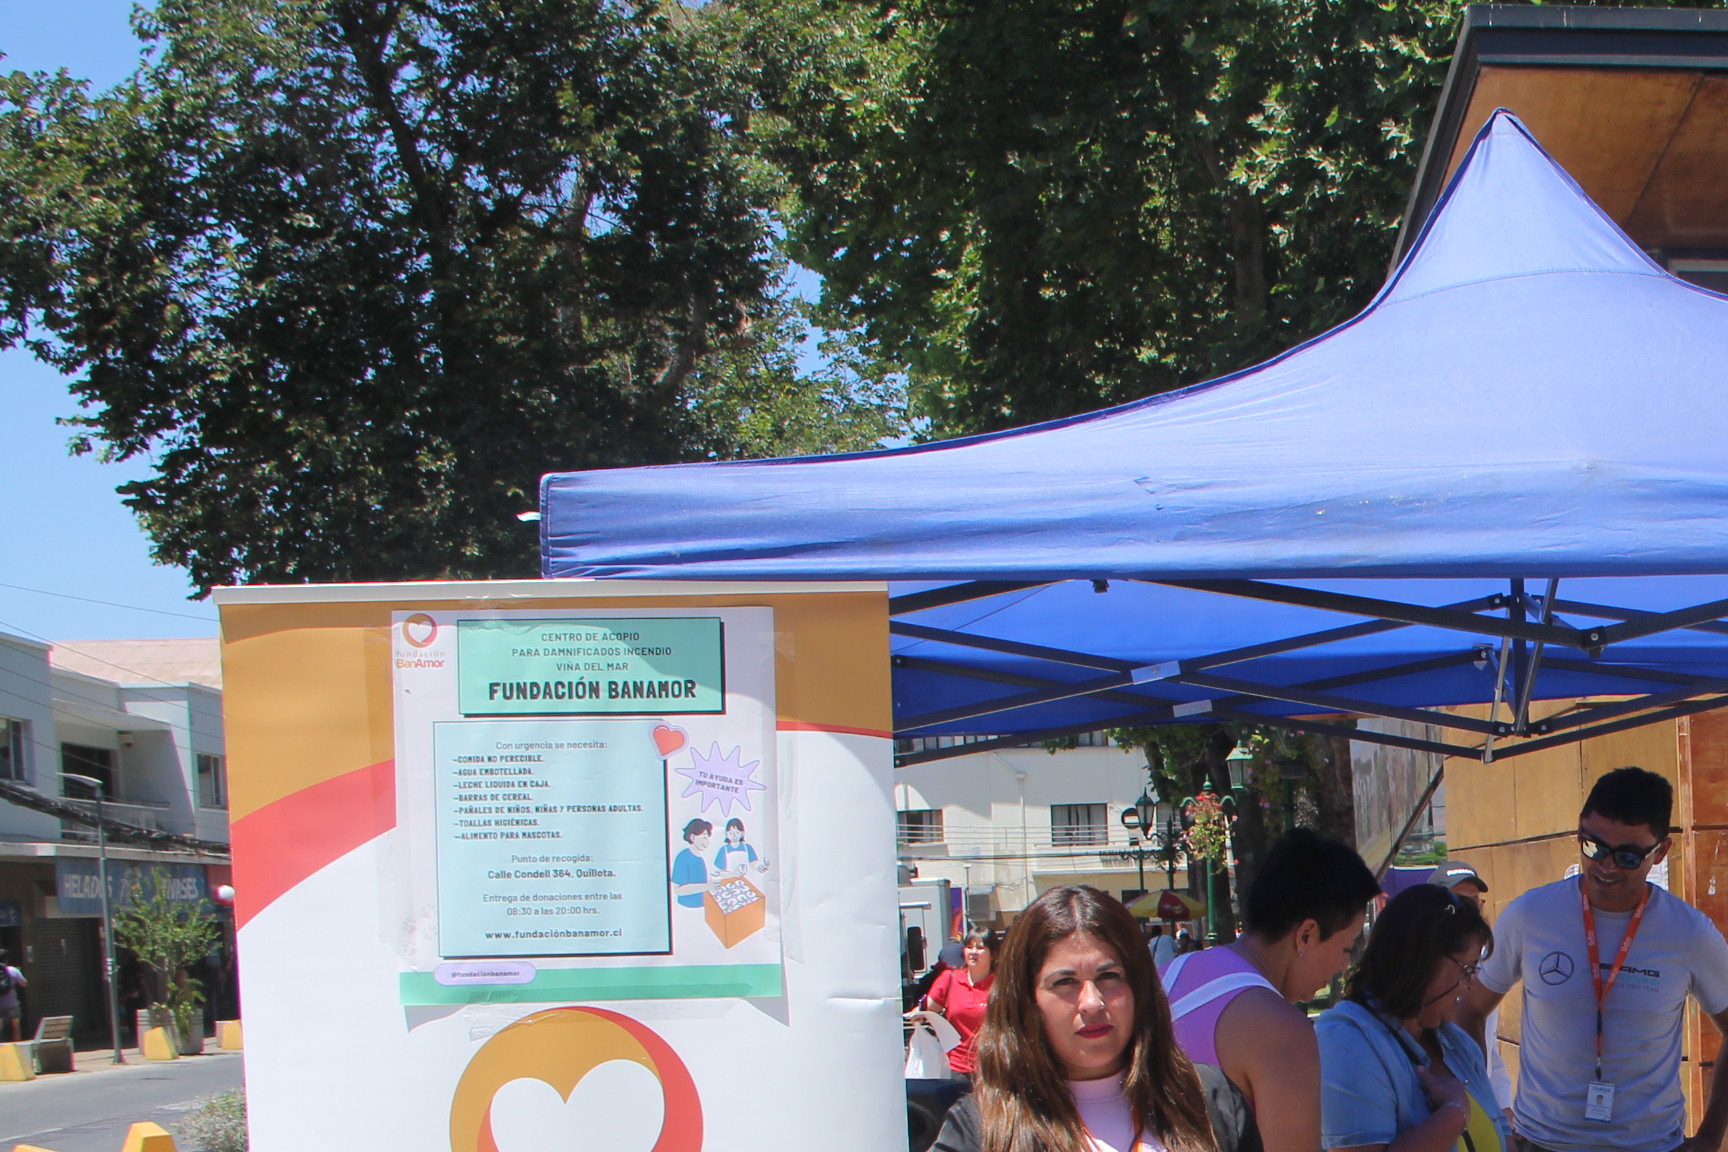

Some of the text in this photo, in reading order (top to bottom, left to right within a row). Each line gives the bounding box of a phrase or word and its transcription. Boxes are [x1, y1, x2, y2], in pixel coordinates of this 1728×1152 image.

[541, 632, 639, 642] CENTRO DE ACOPIO
[512, 646, 672, 657] PARA DAMNIFICADOS INCENDIO
[396, 658, 445, 670] BanAmor
[556, 661, 628, 671] VIÑA DEL MAR
[489, 676, 697, 700] FUNDACIÓN BANAMOR
[496, 741, 513, 750] Con
[515, 741, 552, 751] urgencia
[567, 740, 608, 749] necesita:
[695, 779, 739, 793] IMPORTANTE
[495, 806, 505, 814] DE
[567, 805, 606, 813] PERSONAS
[511, 854, 594, 864] Punto de recogida:
[488, 870, 512, 879] Calle
[514, 870, 550, 879] Condell
[576, 869, 616, 878] Quillota.
[63, 873, 113, 898] HELADS
[483, 892, 622, 903] Entrega de donaciones entre las
[507, 907, 532, 916] 08:30
[541, 907, 554, 915] las
[555, 907, 581, 915] 20:00
[583, 907, 600, 915] hrs.
[485, 928, 622, 939] www.fundaciónbanamor.cl
